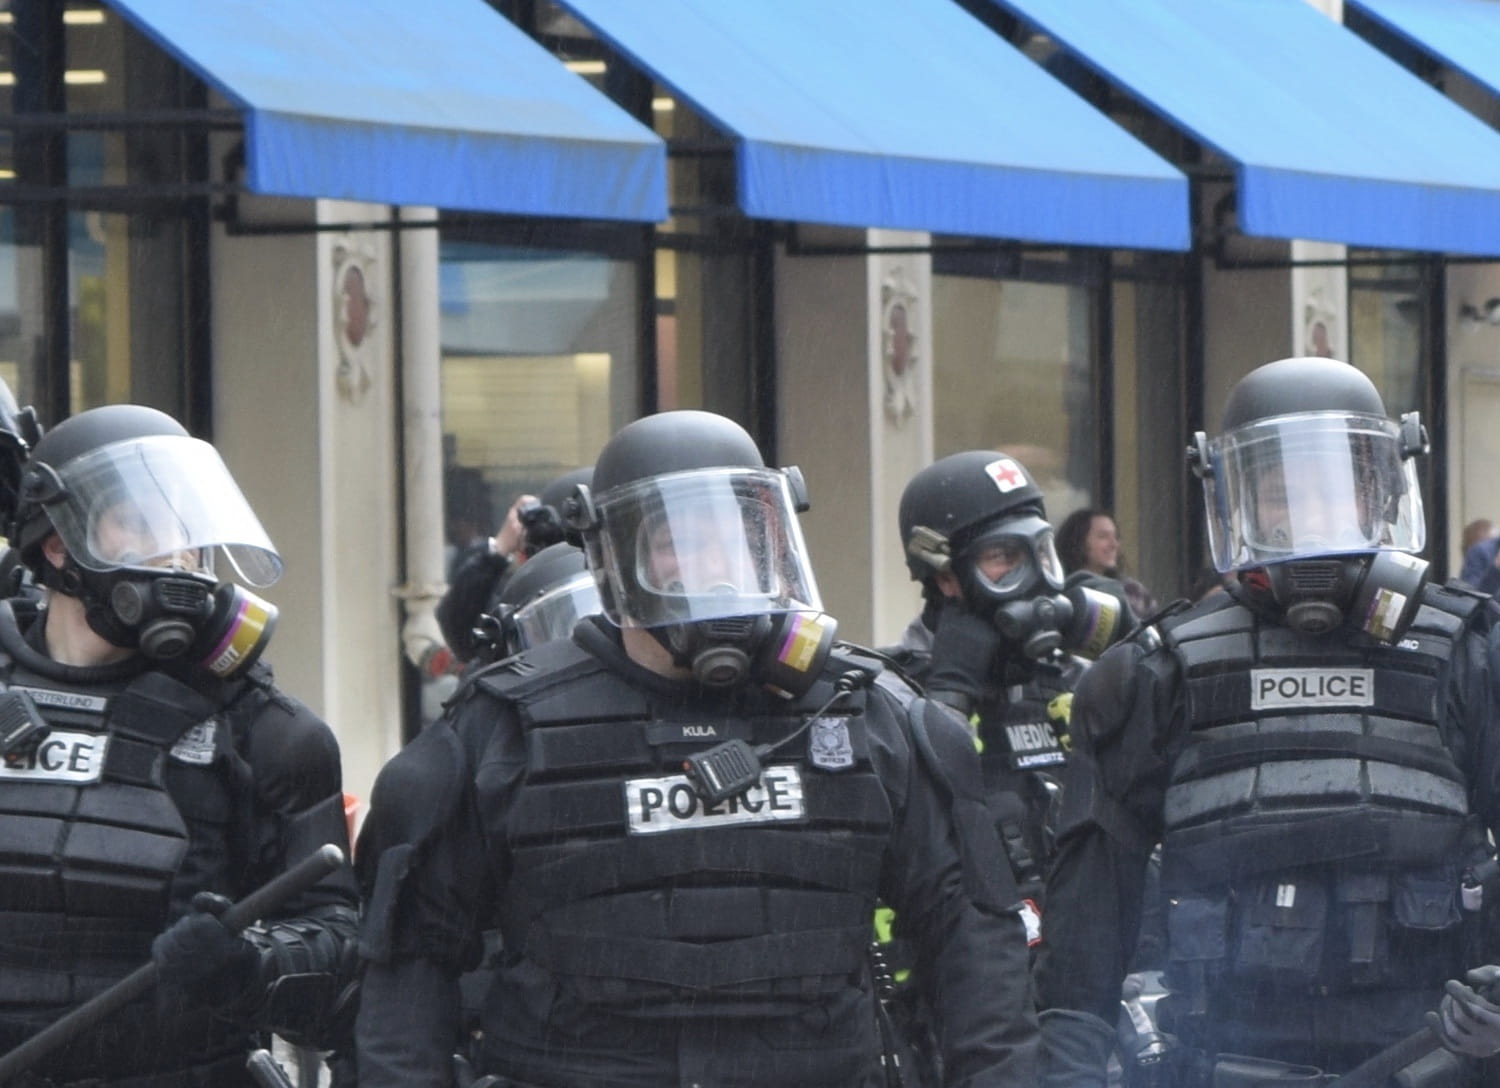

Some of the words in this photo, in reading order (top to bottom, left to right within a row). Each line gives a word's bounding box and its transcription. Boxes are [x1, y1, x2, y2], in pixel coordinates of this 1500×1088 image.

[1259, 675, 1366, 700] POLICE
[29, 691, 94, 709] ESTERLUND
[682, 725, 717, 737] KULA
[1005, 721, 1059, 751] MEDIC
